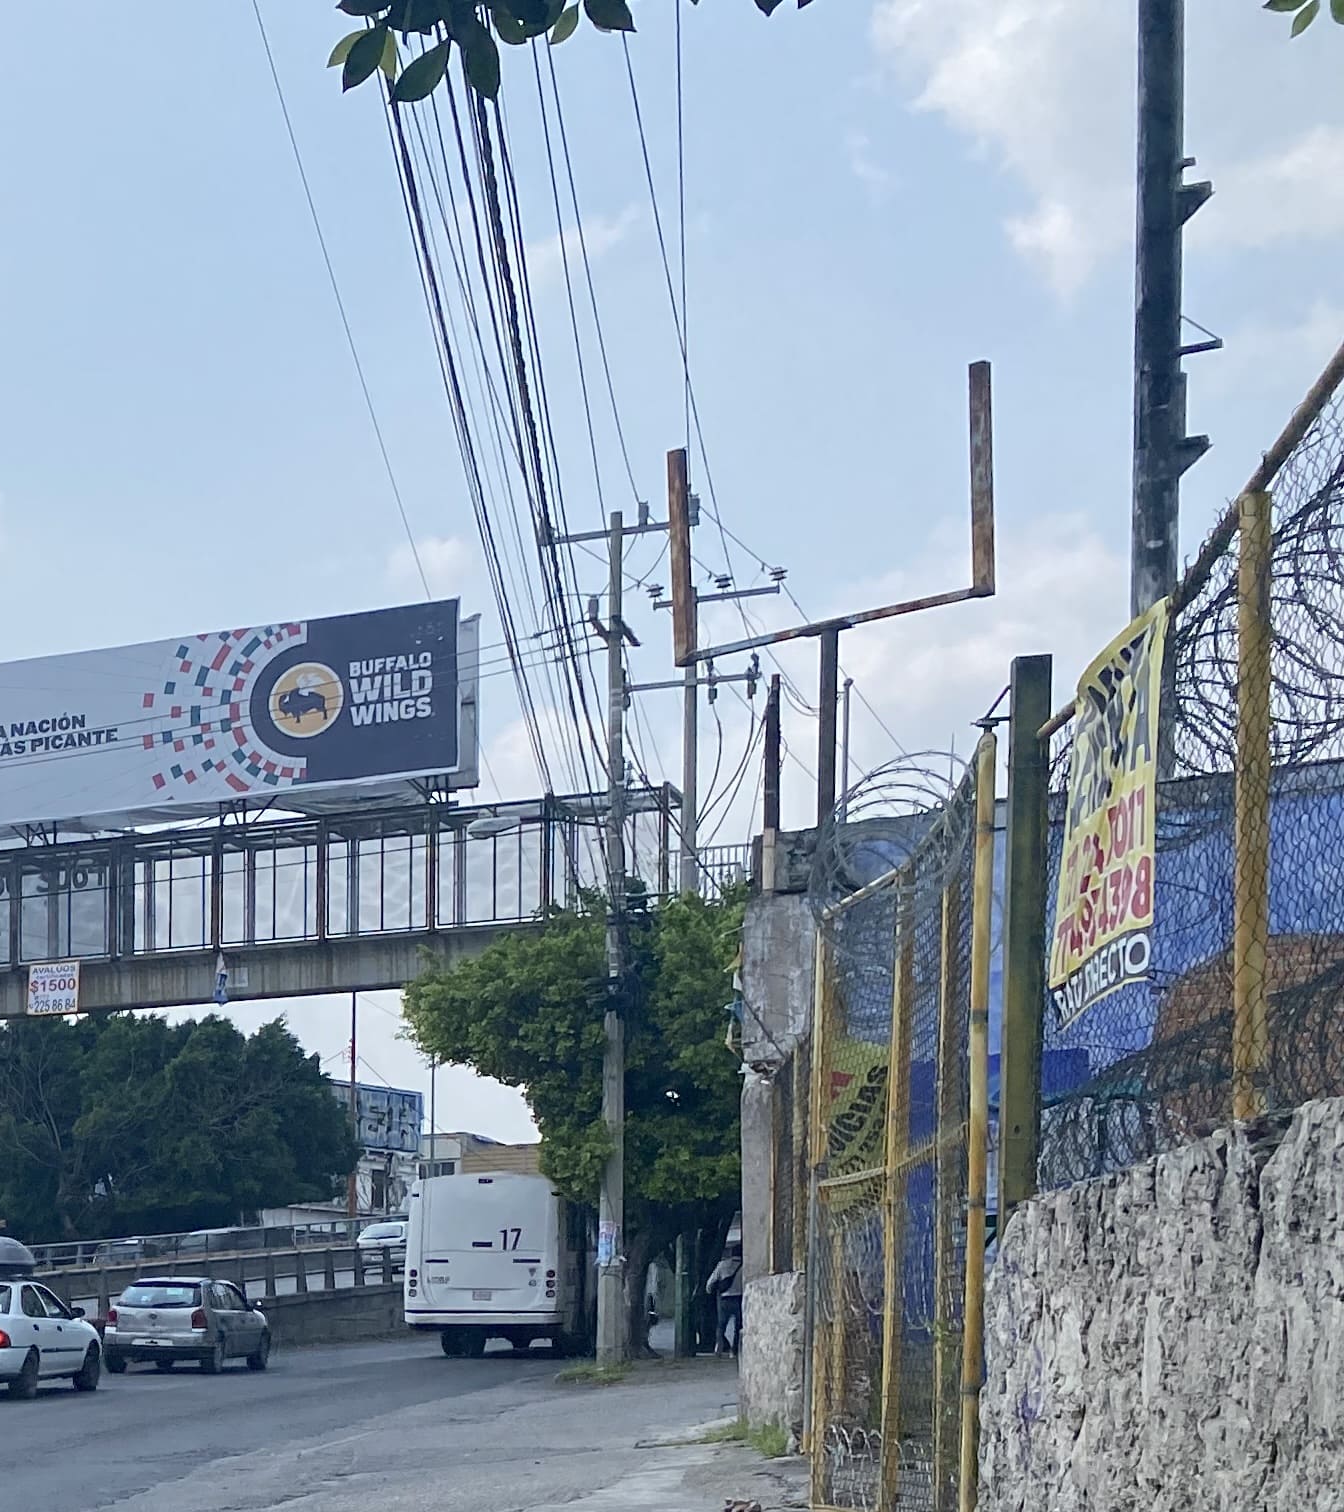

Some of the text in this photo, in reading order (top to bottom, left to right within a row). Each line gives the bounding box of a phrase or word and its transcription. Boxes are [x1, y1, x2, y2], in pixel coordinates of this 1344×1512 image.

[349, 652, 432, 678] BUFFALO
[349, 669, 433, 704] WILD
[350, 696, 432, 726] WINGS
[10, 712, 86, 737] NACIÓN
[30, 728, 119, 753] PICANTE
[30, 977, 76, 995] $1500
[499, 1228, 523, 1251] 17
